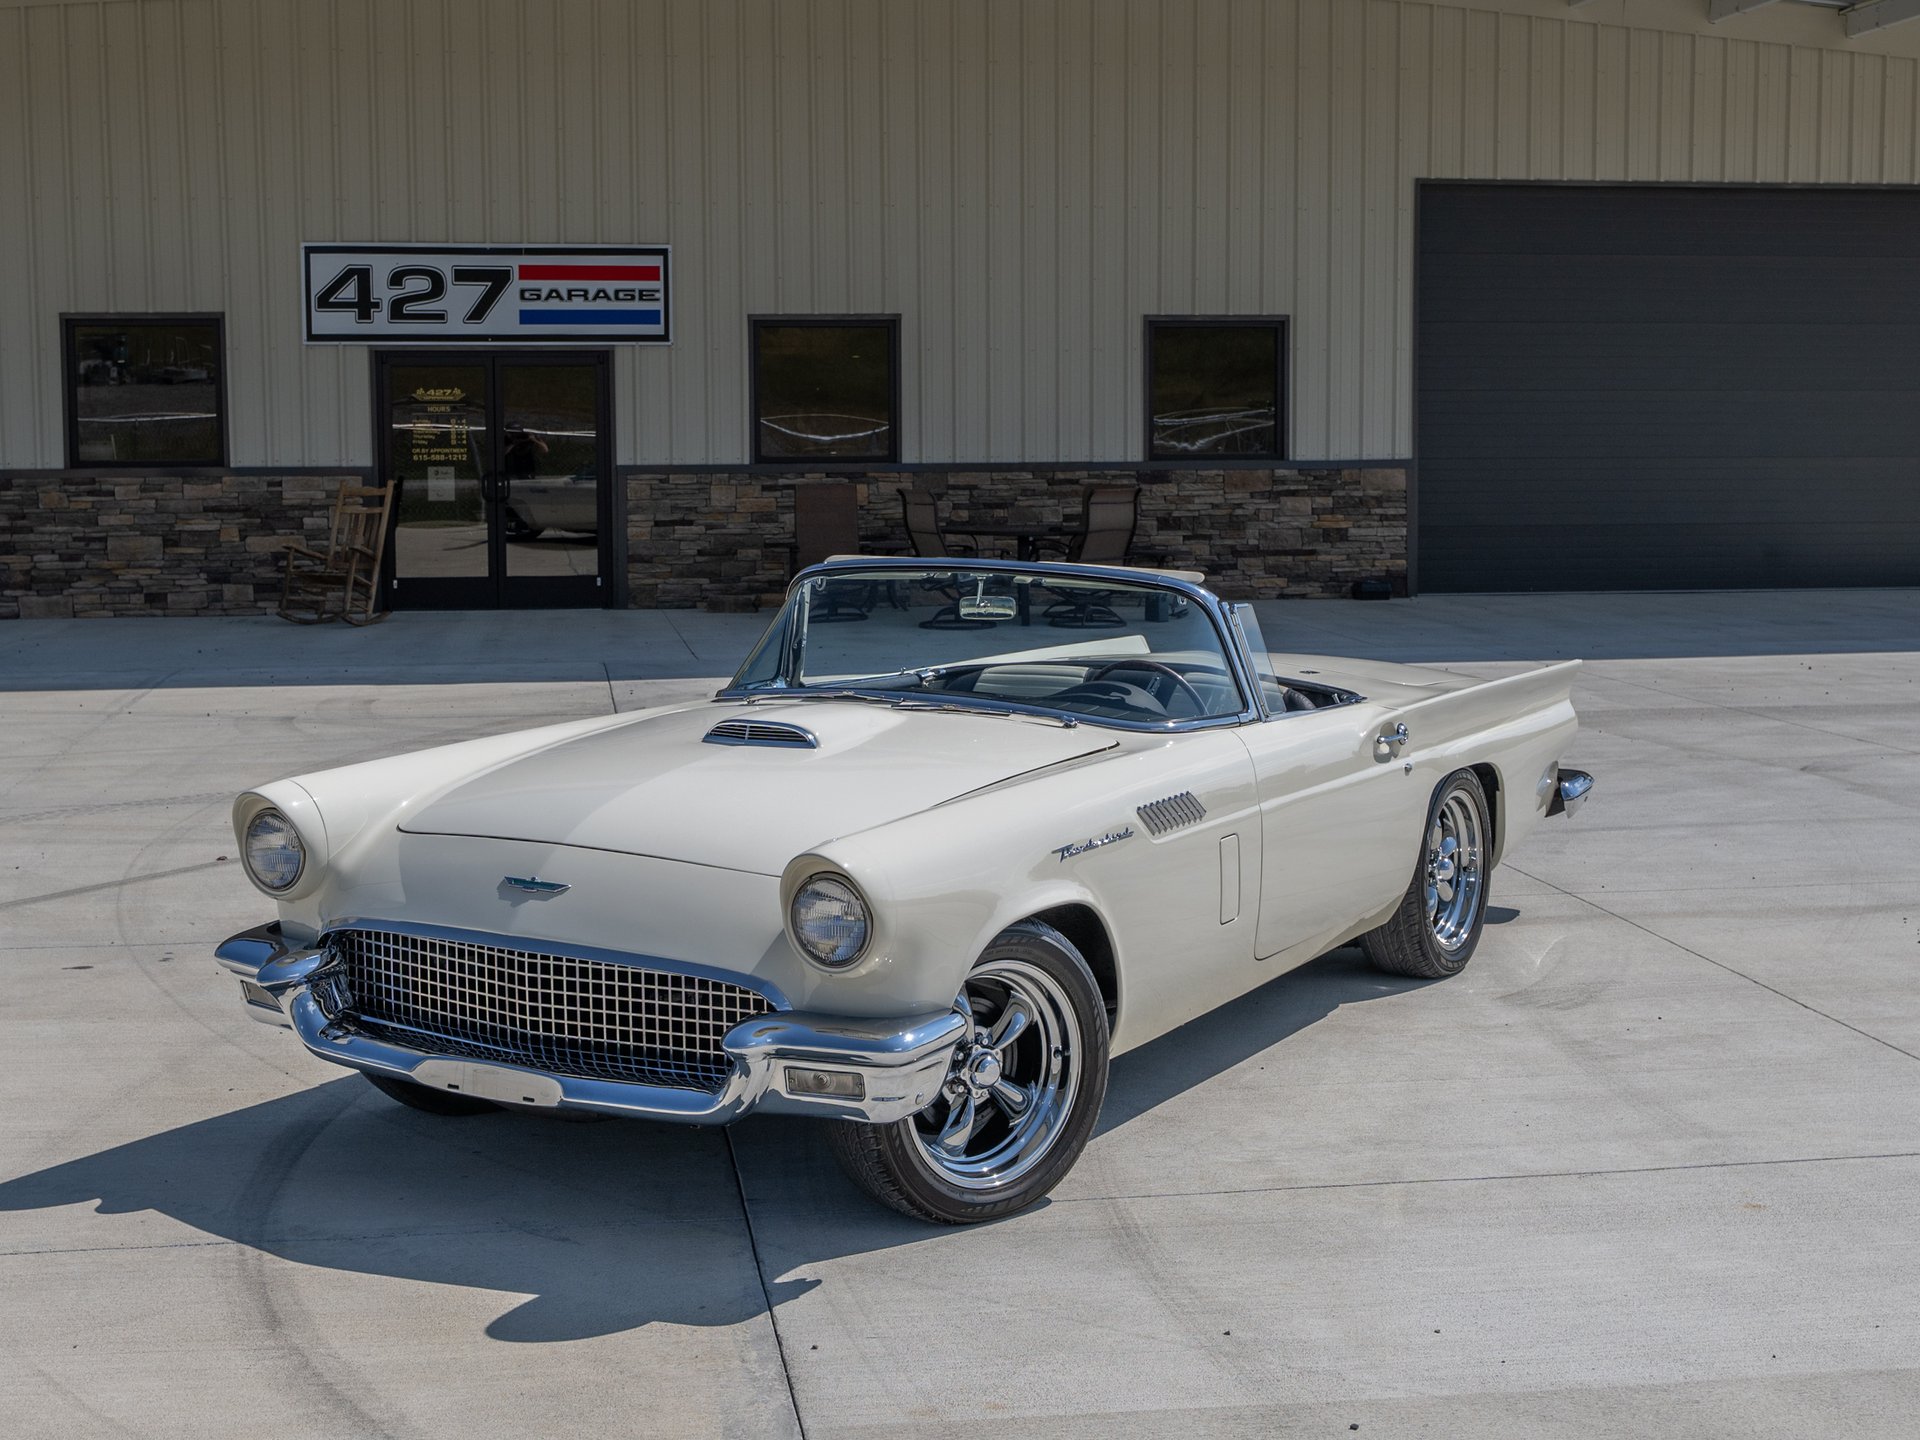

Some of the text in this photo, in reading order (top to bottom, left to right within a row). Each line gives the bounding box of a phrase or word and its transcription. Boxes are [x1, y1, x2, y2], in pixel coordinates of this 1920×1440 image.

[315, 264, 514, 323] 427
[519, 288, 661, 303] GARAGE
[426, 389, 452, 397] 427
[427, 405, 451, 413] HOURS
[1051, 827, 1134, 863] Thunderbird
